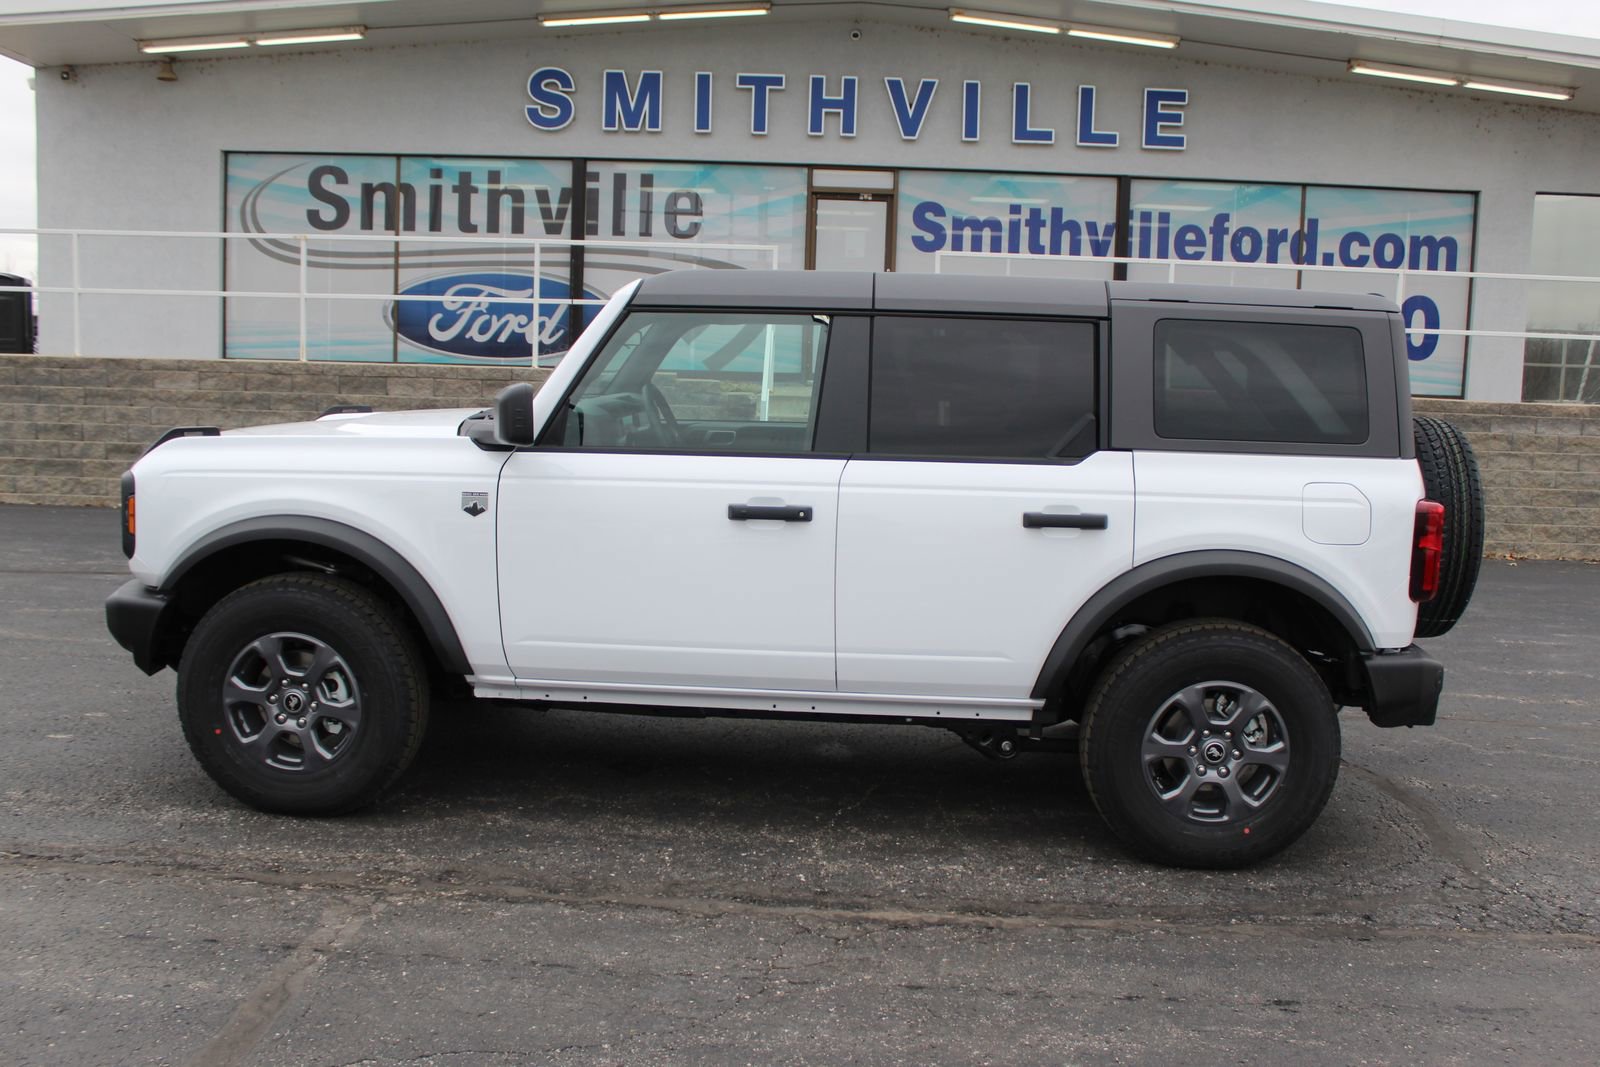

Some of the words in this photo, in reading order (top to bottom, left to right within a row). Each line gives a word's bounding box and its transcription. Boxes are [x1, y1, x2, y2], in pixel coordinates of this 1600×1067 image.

[525, 67, 1189, 151] SMITHVILLE
[305, 165, 704, 240] Smithville
[428, 283, 569, 345] Ford
